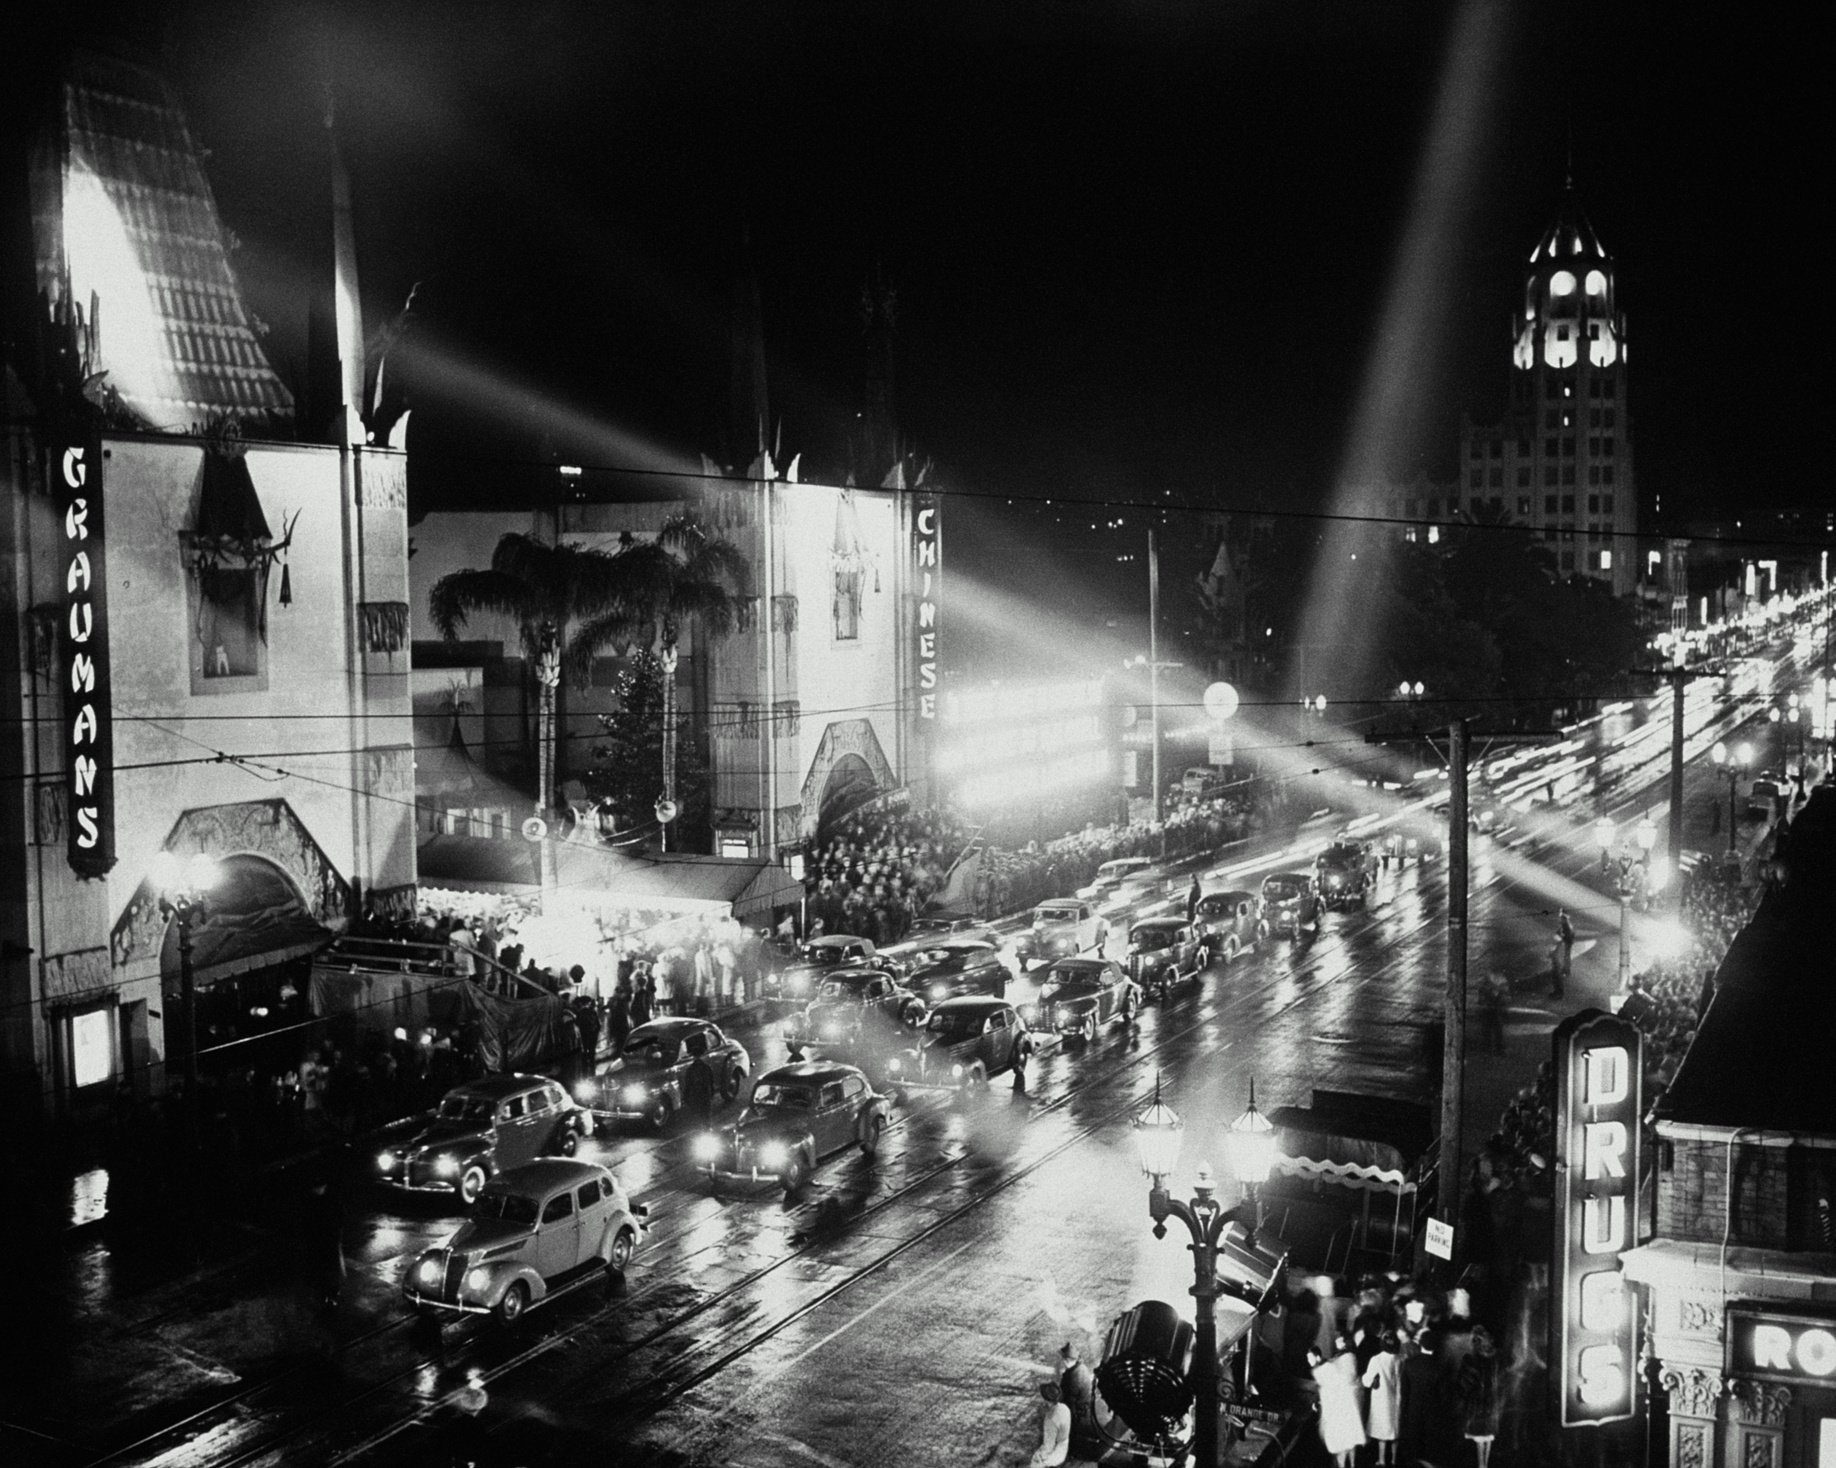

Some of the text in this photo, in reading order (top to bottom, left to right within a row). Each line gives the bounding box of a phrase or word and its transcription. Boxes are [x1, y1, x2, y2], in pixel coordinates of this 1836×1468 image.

[917, 509, 937, 719] CHINESE
[63, 447, 98, 848] GRAUMANS
[1427, 1231, 1450, 1249] PARKING
[1435, 1224, 1445, 1235] NO
[1579, 1046, 1629, 1408] DRUGS
[1754, 1325, 1836, 1376] RO
[1230, 1404, 1264, 1419] ORANGE
